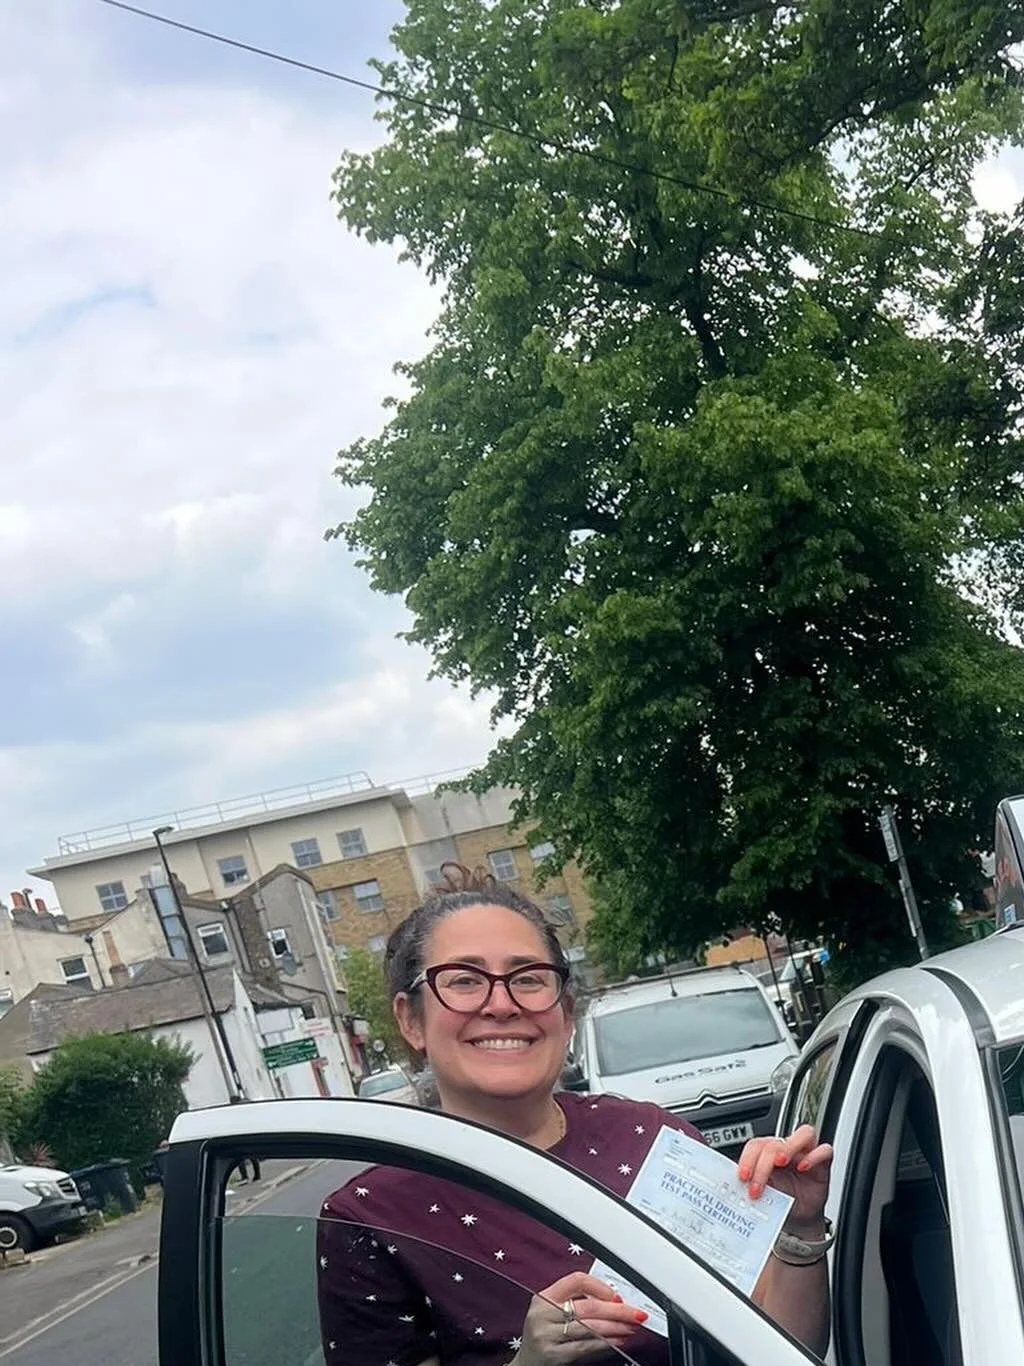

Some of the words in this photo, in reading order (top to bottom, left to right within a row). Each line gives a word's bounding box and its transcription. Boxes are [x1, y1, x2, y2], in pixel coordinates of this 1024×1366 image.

[661, 1180, 681, 1195] TEST
[681, 1191, 702, 1207] PASS
[702, 1203, 752, 1238] CERTIFICATE
[663, 1171, 715, 1204] PRACTICAL
[715, 1199, 756, 1231] DRIVING
